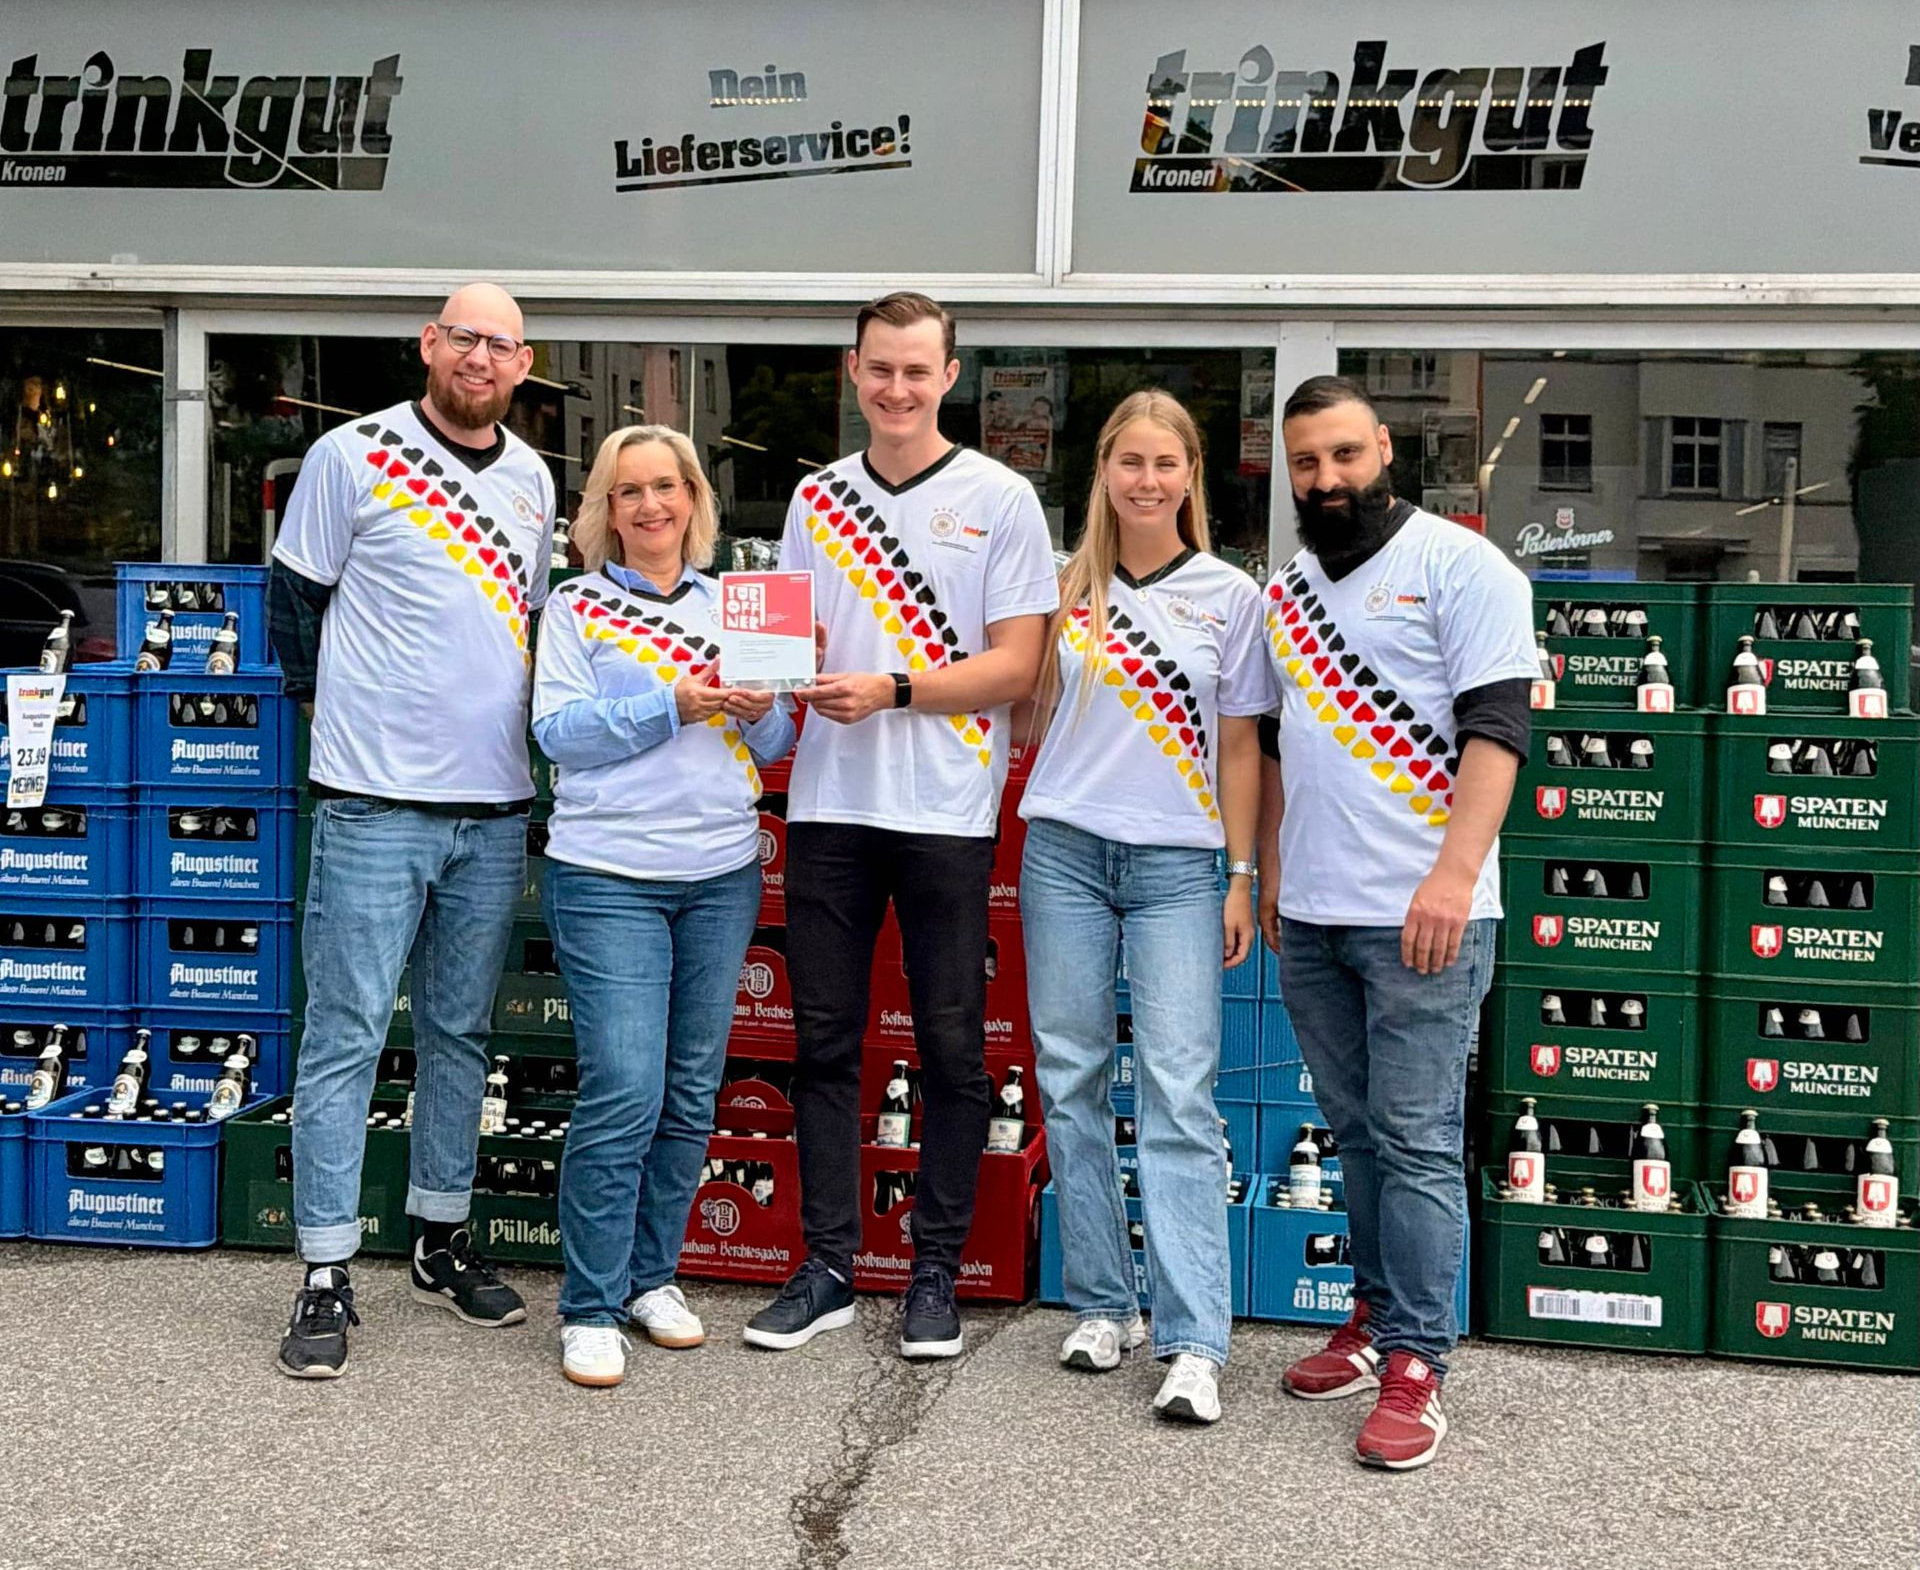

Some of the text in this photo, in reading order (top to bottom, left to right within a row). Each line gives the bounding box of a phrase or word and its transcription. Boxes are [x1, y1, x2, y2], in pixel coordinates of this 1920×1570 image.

[709, 65, 807, 107] Dein
[0, 49, 403, 184] trinkgut
[1141, 41, 1609, 183] trinkgut
[614, 115, 910, 178] Lieferservice!
[2, 160, 66, 181] Kronen
[1142, 162, 1217, 187] Kronen
[1515, 523, 1614, 557] Paderborner
[1777, 660, 1854, 677] SPATE
[172, 739, 259, 761] Augustiner
[1571, 788, 1664, 808] SPATEN
[1790, 796, 1888, 817] SPATEN
[0, 848, 88, 871] Augustiner
[171, 852, 258, 875] Augustiner
[1567, 917, 1660, 938] SPATEN
[1787, 927, 1883, 948] SPATEN
[0, 958, 86, 981] Augustiner
[170, 963, 258, 986] Augustiner
[1565, 1047, 1657, 1068] SPATEN
[1783, 1062, 1879, 1084] SPATEN
[68, 1189, 165, 1214] Augustiner
[489, 1218, 560, 1246] Pülleke
[720, 1241, 790, 1262] Berchtesgaden
[852, 1251, 911, 1270] Hofbrauhau
[1795, 1306, 1895, 1330] SPATEN
